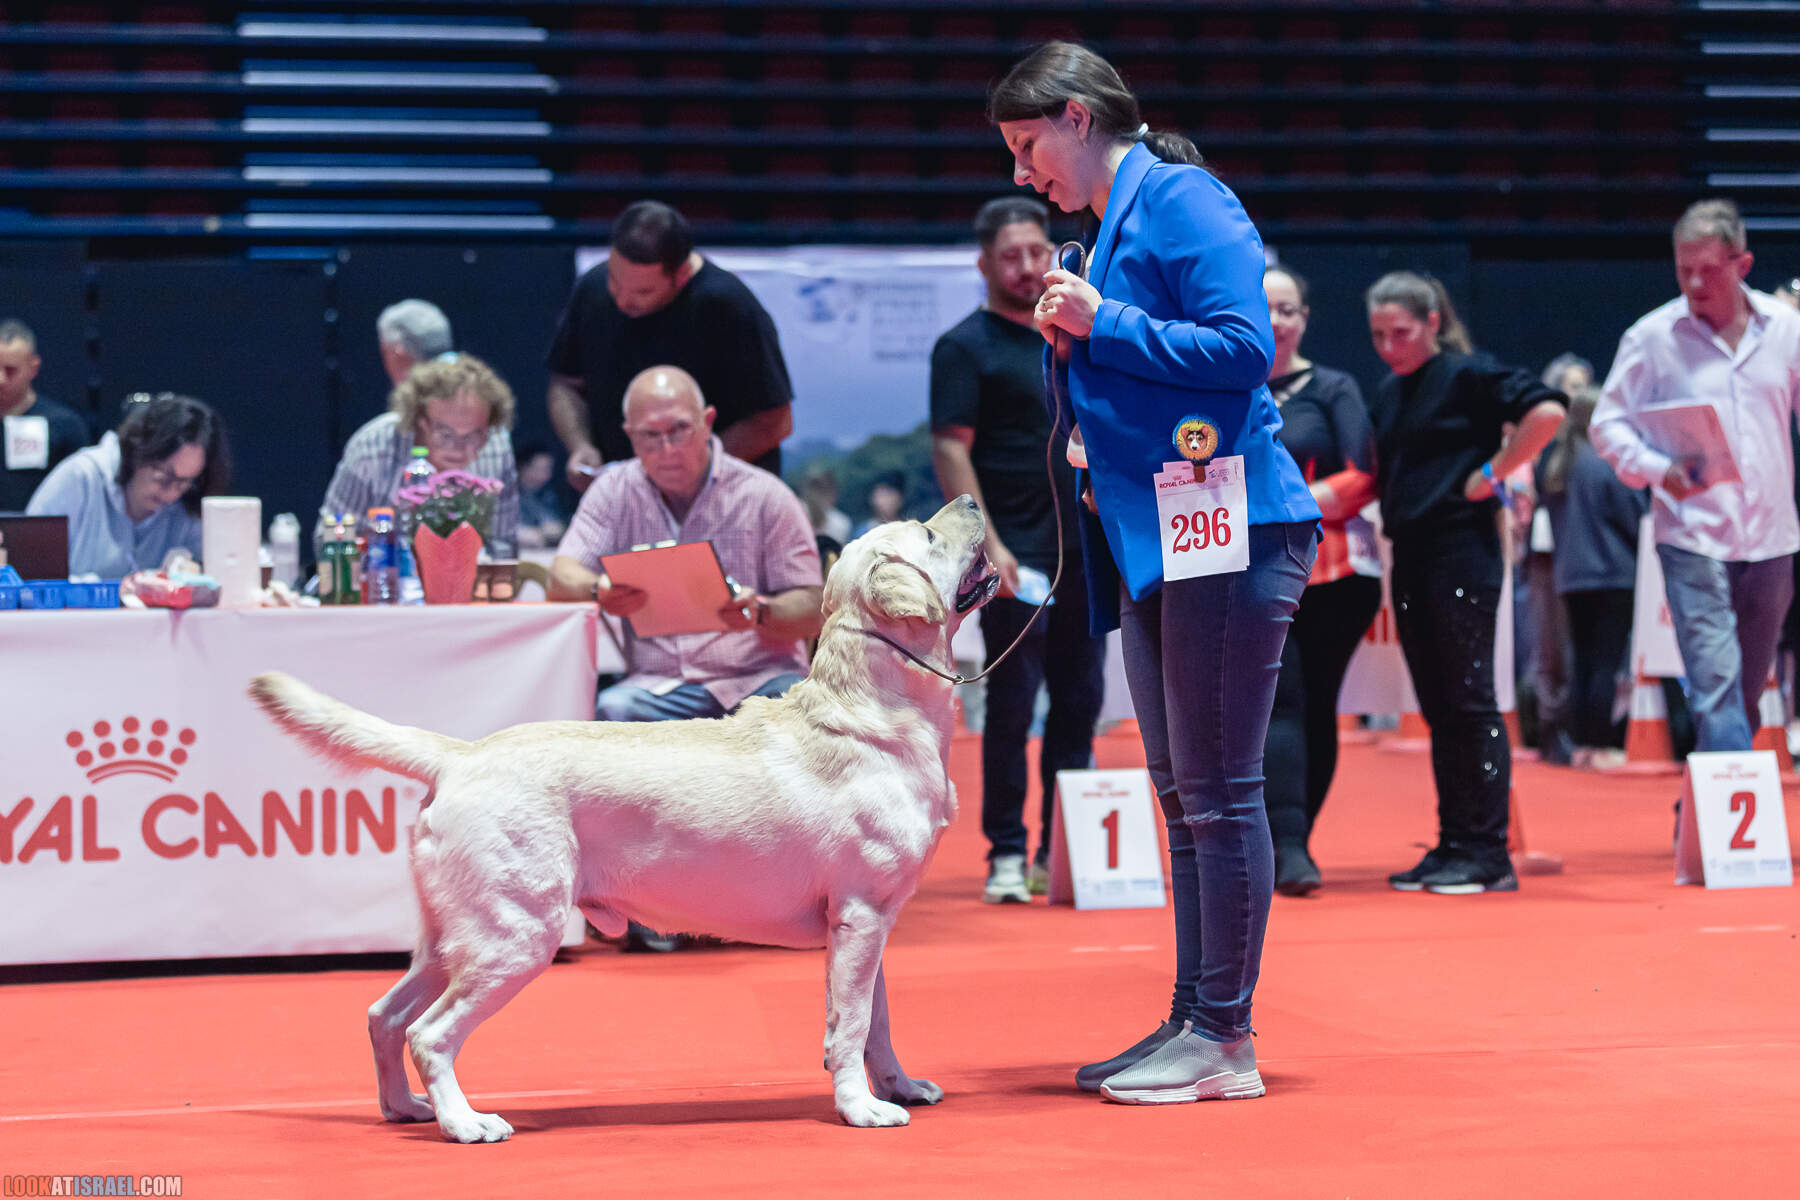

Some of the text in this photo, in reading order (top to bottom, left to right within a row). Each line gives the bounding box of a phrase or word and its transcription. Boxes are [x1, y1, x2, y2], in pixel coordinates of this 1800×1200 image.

[1170, 507, 1232, 554] 296
[141, 785, 397, 860] CANIN
[1101, 809, 1120, 870] 1
[1729, 790, 1757, 850] 2
